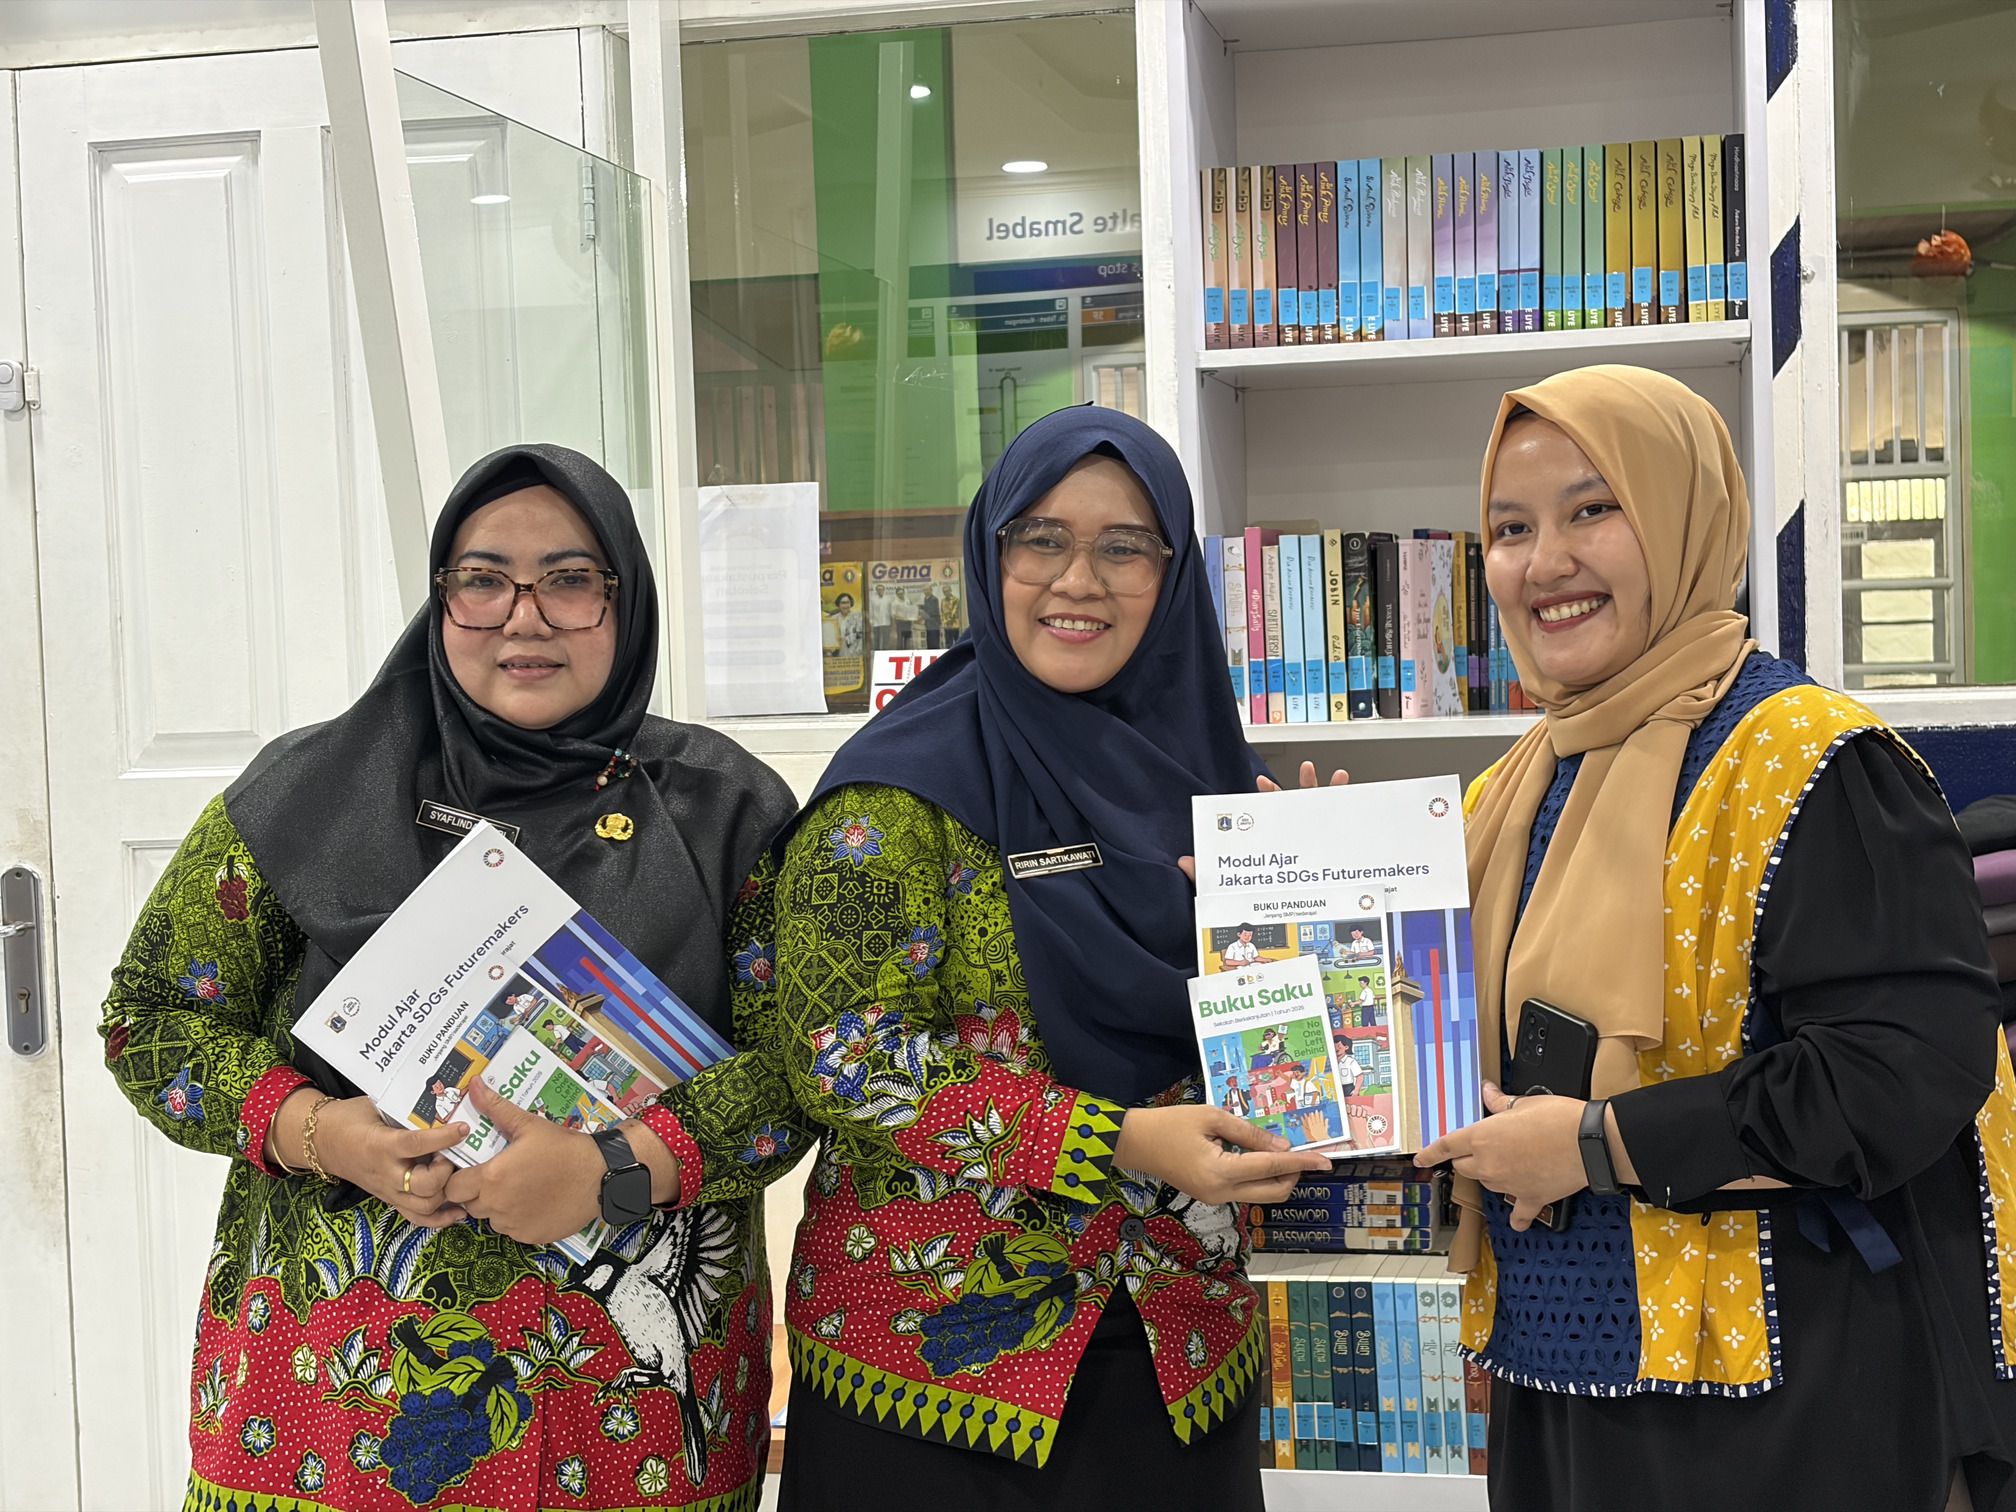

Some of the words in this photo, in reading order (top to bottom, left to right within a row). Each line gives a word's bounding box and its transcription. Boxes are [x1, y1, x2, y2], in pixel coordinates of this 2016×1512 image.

[1482, 313, 1490, 329] LIYE
[1525, 315, 1533, 331] LIYE
[1547, 312, 1555, 327] LIYE
[1590, 309, 1598, 325] LIYE
[1640, 309, 1649, 325] LIYE
[1668, 307, 1676, 323] LIYE
[1441, 317, 1449, 333] LIYE
[1462, 316, 1470, 331] LIYE
[1505, 316, 1513, 332] LIYE
[1285, 327, 1293, 343] LIYE
[1305, 326, 1313, 342] LIYE
[1325, 324, 1333, 340] LIYE
[1368, 325, 1376, 340] LIYE
[872, 563, 932, 580] Gema
[1329, 570, 1340, 606] JOBIN
[1268, 609, 1278, 632] SABTU
[1015, 859, 1038, 870] RIRIN
[1039, 850, 1096, 867] SARTIKAWATI
[1218, 854, 1265, 868] Modul
[1269, 853, 1299, 868] Ajar
[1218, 873, 1273, 887] Jakarta
[1277, 870, 1319, 884] SDGs
[1322, 863, 1430, 881] Futuremakers
[1253, 902, 1278, 912] BUKU
[1281, 899, 1326, 910] PANDUAN
[374, 1023, 417, 1072] Jakarta
[413, 986, 448, 1023] SDGs
[444, 904, 529, 988] Futuremakers
[1199, 994, 1255, 1018] Buku
[1257, 983, 1313, 1006] Saku
[358, 1014, 398, 1060] Modul
[395, 988, 421, 1019] Ajar
[1307, 1021, 1320, 1029] No
[418, 1041, 438, 1065] BUKU
[436, 1001, 469, 1041] PANDUAN
[1303, 1029, 1321, 1038] One
[1305, 1037, 1323, 1046] Left
[1294, 1045, 1325, 1058] Behind
[552, 1072, 563, 1085] No
[555, 1078, 569, 1094] One
[561, 1081, 576, 1100] Left
[465, 1114, 494, 1152] Buk
[498, 1050, 541, 1100] Saku
[559, 1087, 581, 1114] Behind
[1290, 1186, 1331, 1200] SWORD
[1271, 1208, 1330, 1223] PASSWORD
[1272, 1231, 1331, 1246] PASSWORD
[1333, 1329, 1348, 1355] BULAN
[1356, 1330, 1371, 1356] BULAN
